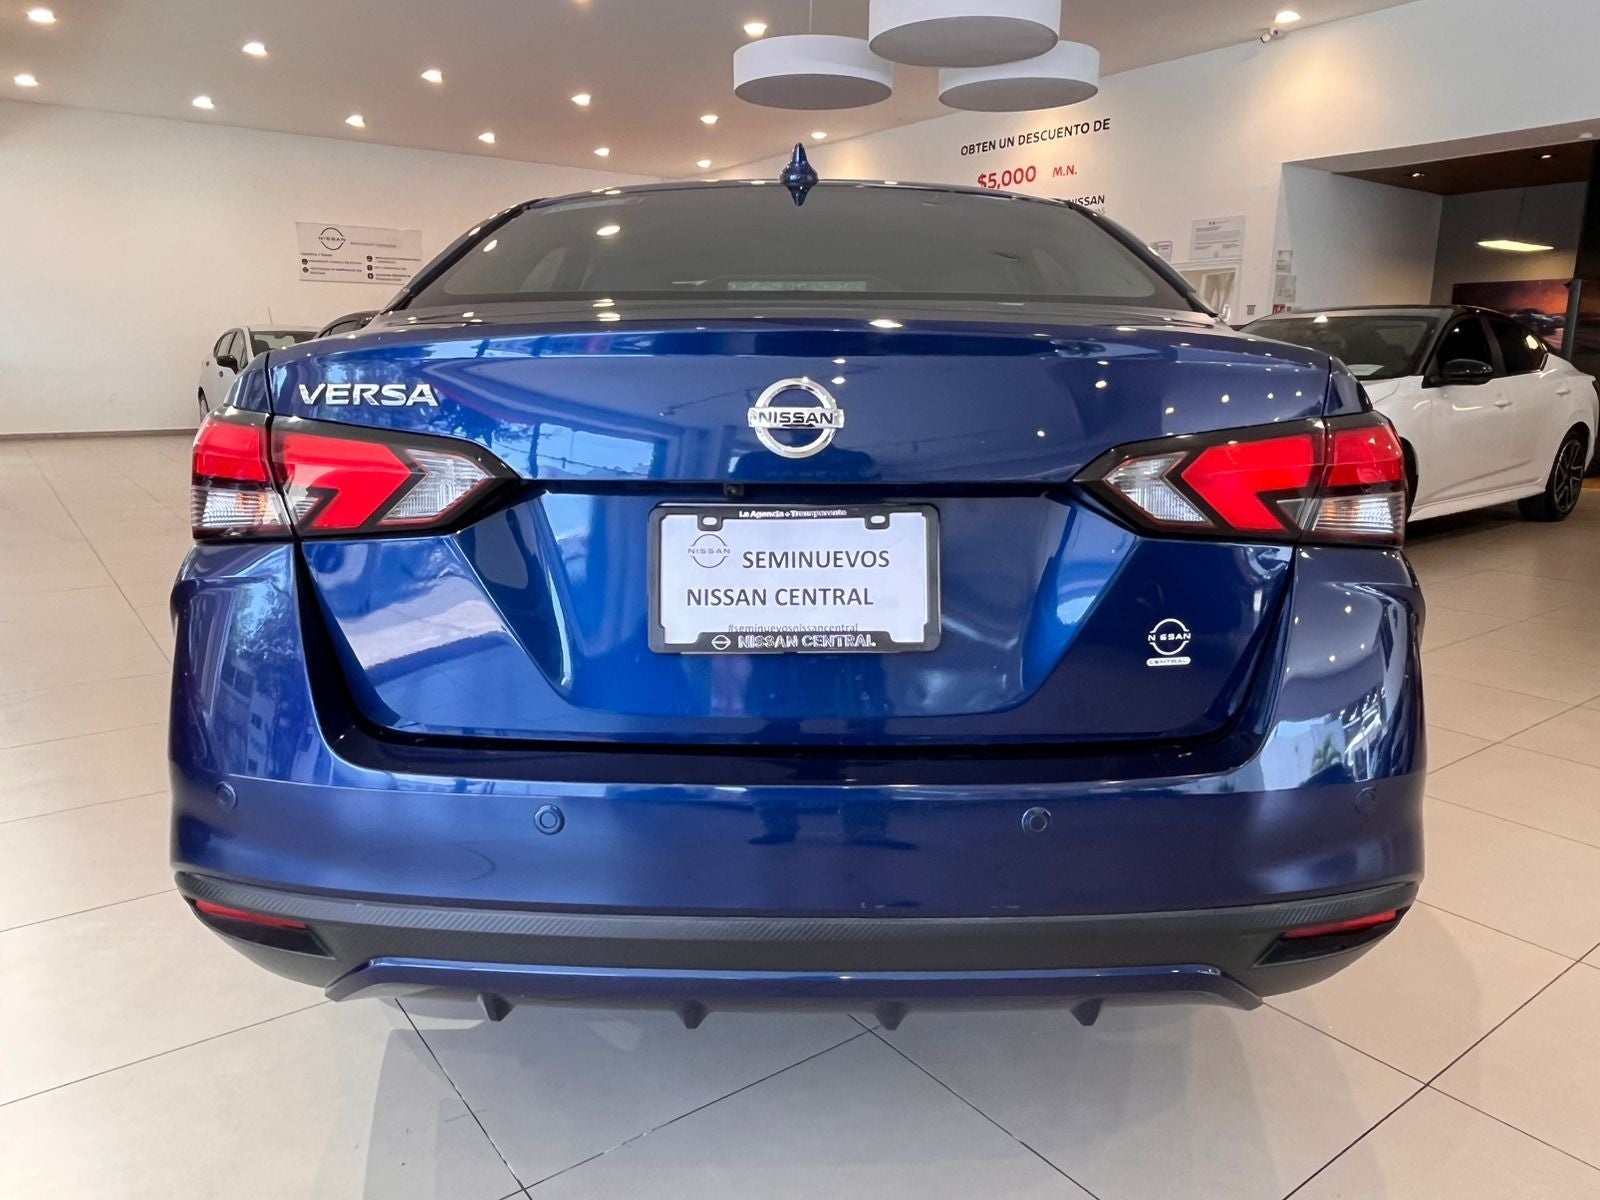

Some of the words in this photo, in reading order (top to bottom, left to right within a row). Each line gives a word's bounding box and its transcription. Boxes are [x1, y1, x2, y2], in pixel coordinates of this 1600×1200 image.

[961, 139, 996, 156] OBTEN
[999, 136, 1015, 149] UN
[1018, 122, 1090, 146] DESCUENTO
[1093, 118, 1111, 131] DE
[977, 165, 1037, 189] $5,000
[1052, 164, 1077, 177] M.N.
[299, 383, 439, 407] VERSA
[759, 412, 834, 424] NISSAN
[750, 510, 785, 519] Agencia
[688, 547, 731, 555] NISSAN
[742, 550, 890, 569] SEMINUEVOS
[687, 588, 767, 606] NISSAN
[774, 587, 874, 606] CENTRAL
[737, 635, 799, 649] NISSAN
